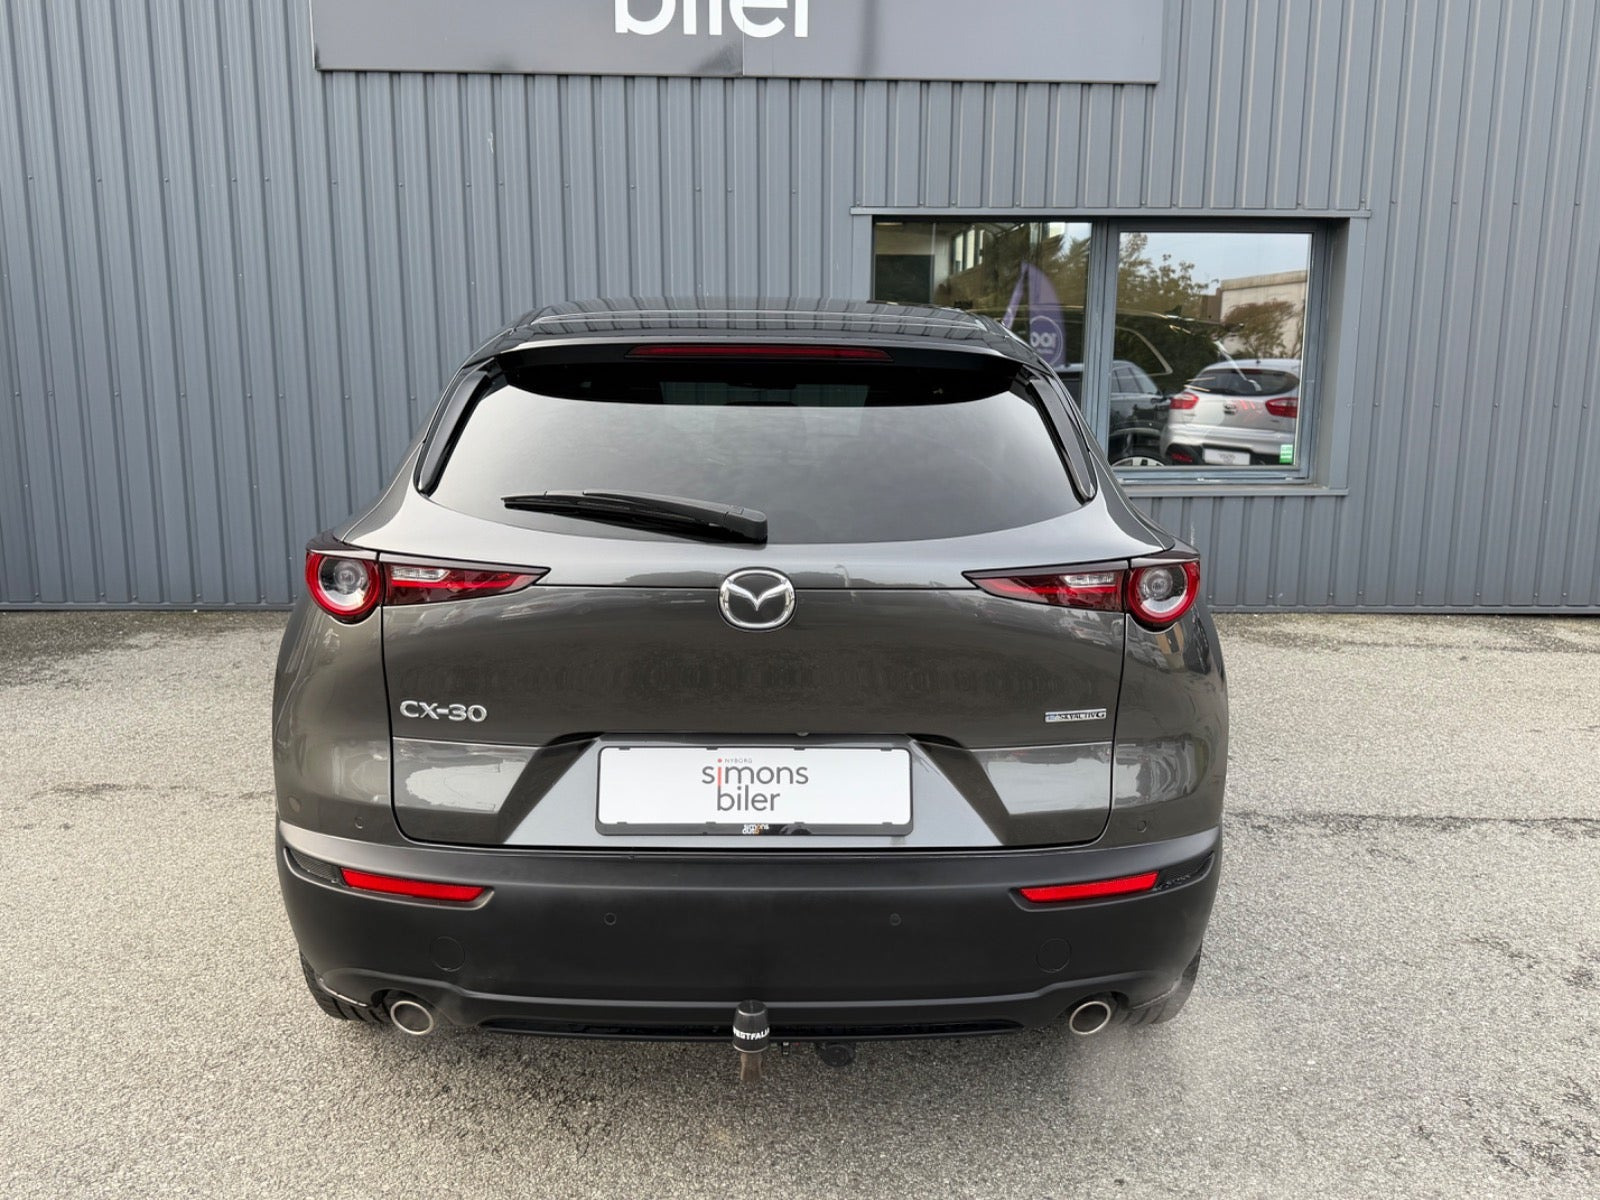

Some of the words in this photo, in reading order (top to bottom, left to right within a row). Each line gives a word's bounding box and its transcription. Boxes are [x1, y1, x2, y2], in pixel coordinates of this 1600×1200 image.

[400, 700, 487, 722] CX-30
[702, 758, 809, 785] simons
[717, 784, 781, 811] biler
